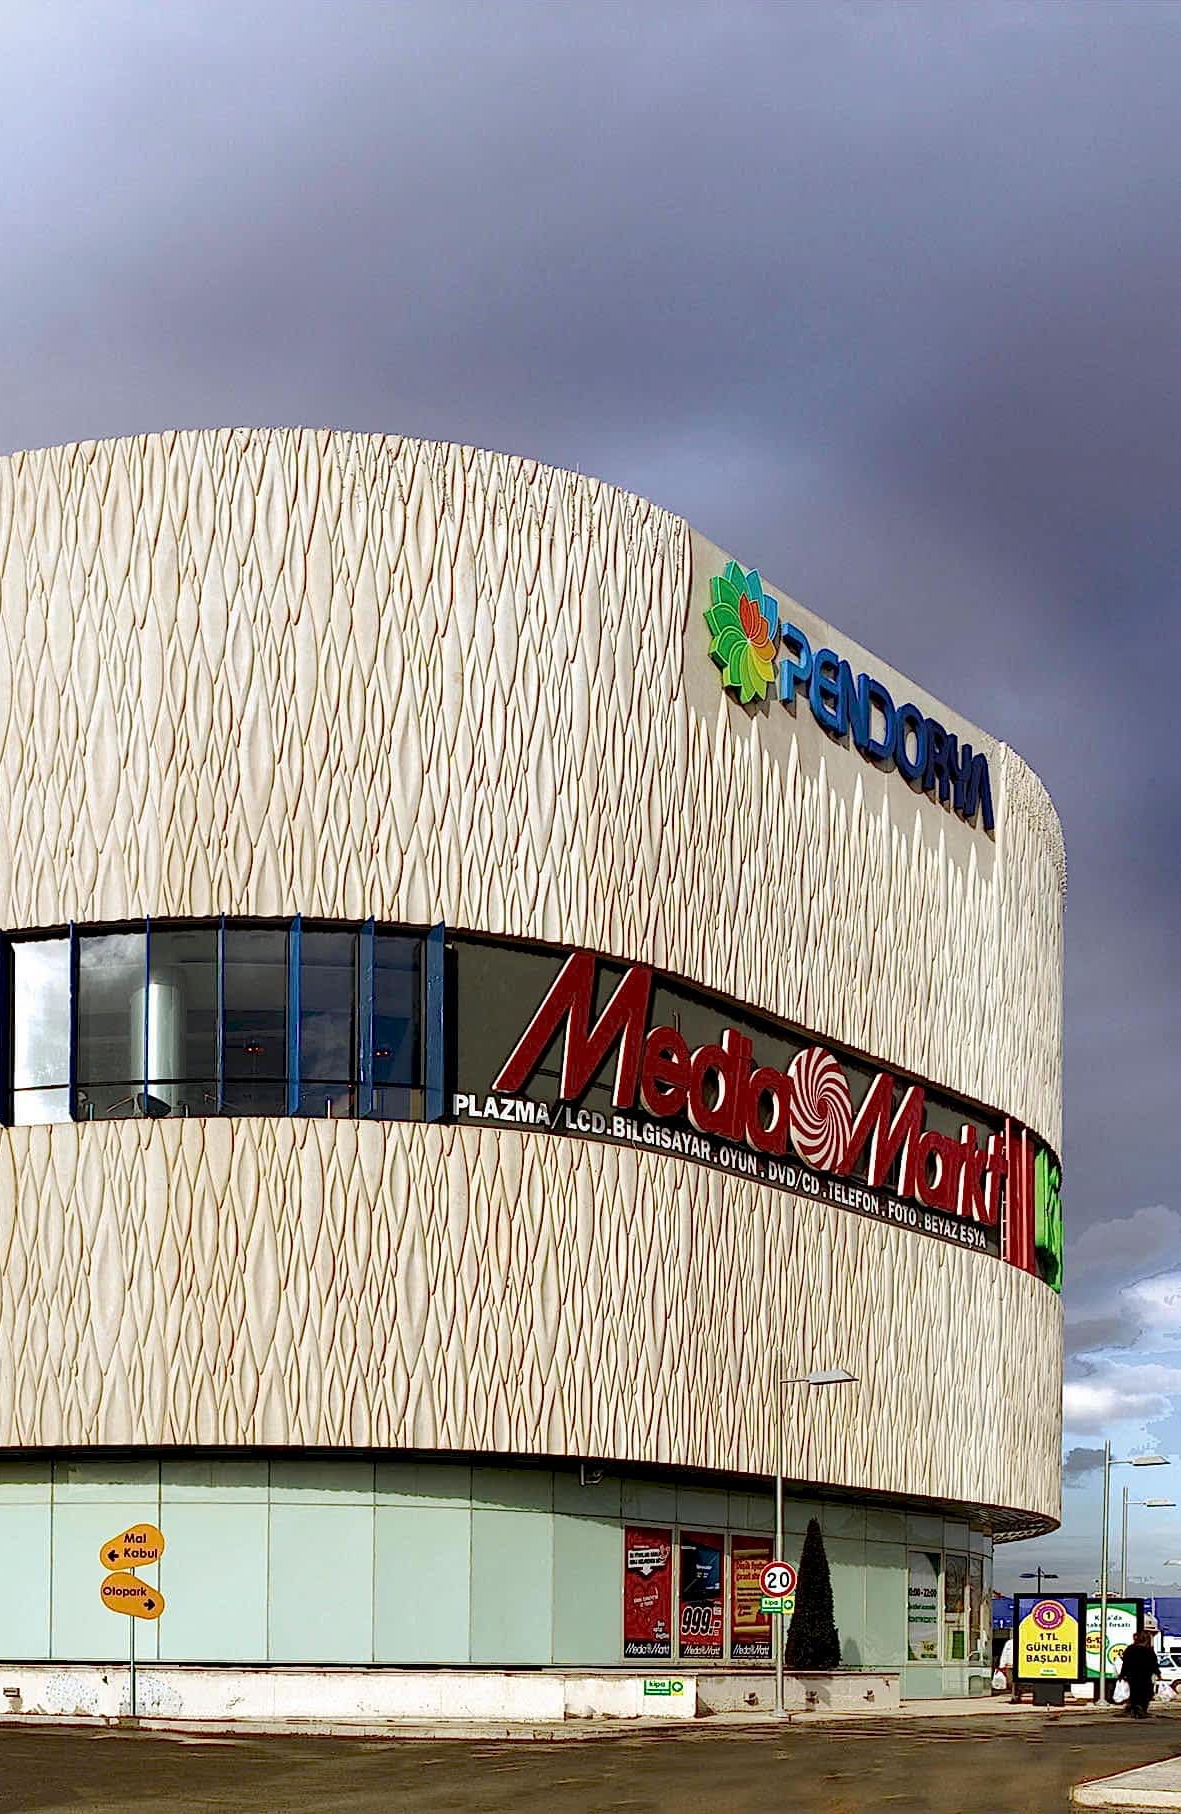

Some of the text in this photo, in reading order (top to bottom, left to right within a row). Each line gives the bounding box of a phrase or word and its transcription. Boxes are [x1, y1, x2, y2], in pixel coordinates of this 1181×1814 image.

[123, 1533, 147, 1543] Mal
[123, 1548, 157, 1558] Kabul
[767, 1571, 790, 1588] 20
